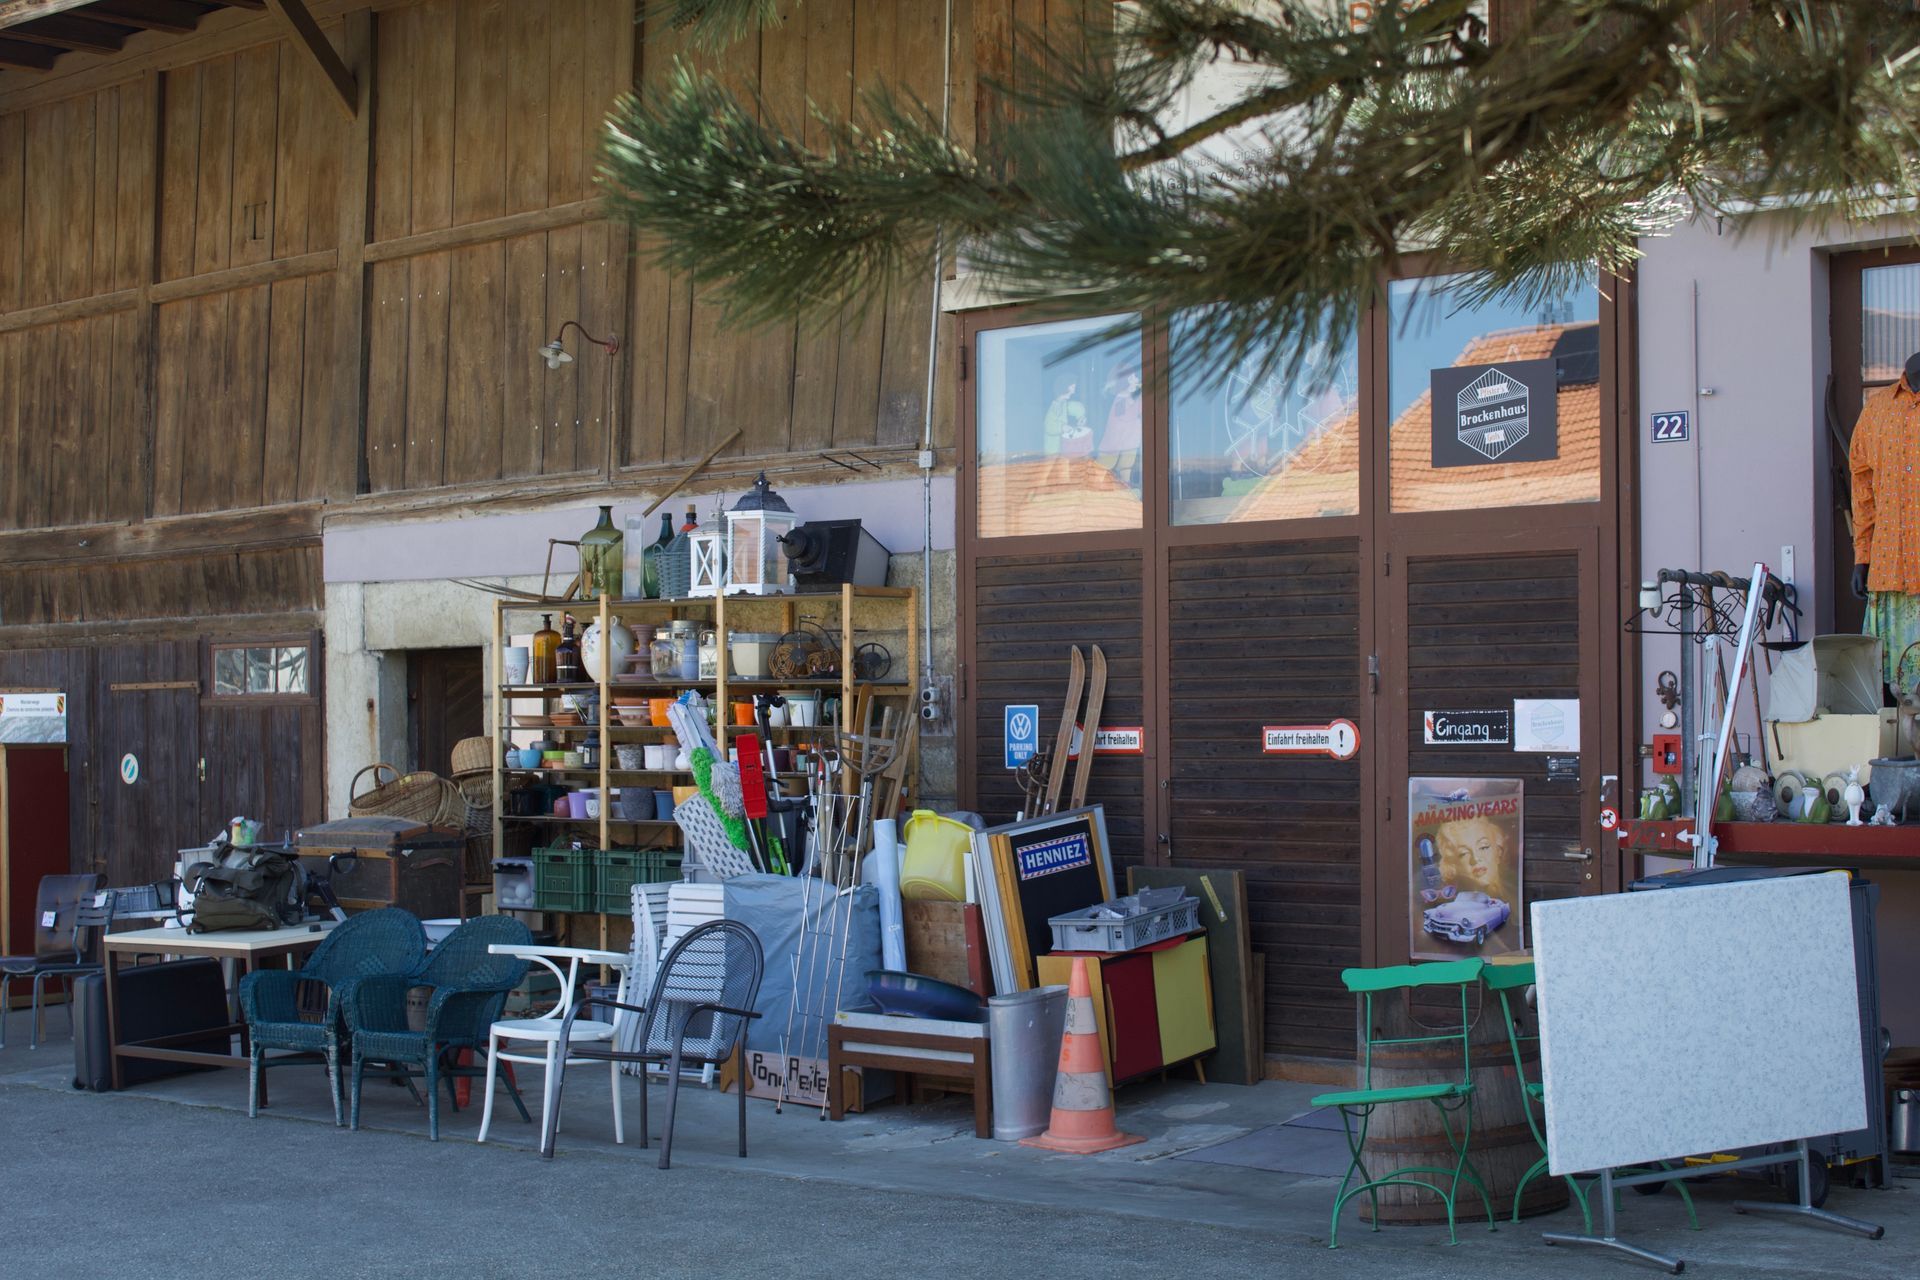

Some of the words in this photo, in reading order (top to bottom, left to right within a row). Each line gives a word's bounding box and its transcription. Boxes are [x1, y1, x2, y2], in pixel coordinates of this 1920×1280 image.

[1460, 404, 1526, 427] Brockenhaus
[1656, 416, 1682, 439] 22
[1267, 733, 1294, 745] Einfahrt
[1295, 733, 1329, 745] freihalten
[1436, 717, 1489, 741] Eingang
[1009, 743, 1033, 752] PARKING
[1014, 752, 1028, 760] ONLY
[1415, 804, 1475, 827] AMAZING
[1476, 798, 1518, 818] YEARS
[1026, 843, 1082, 869] HENNIEZ
[789, 1057, 829, 1096] Reite
